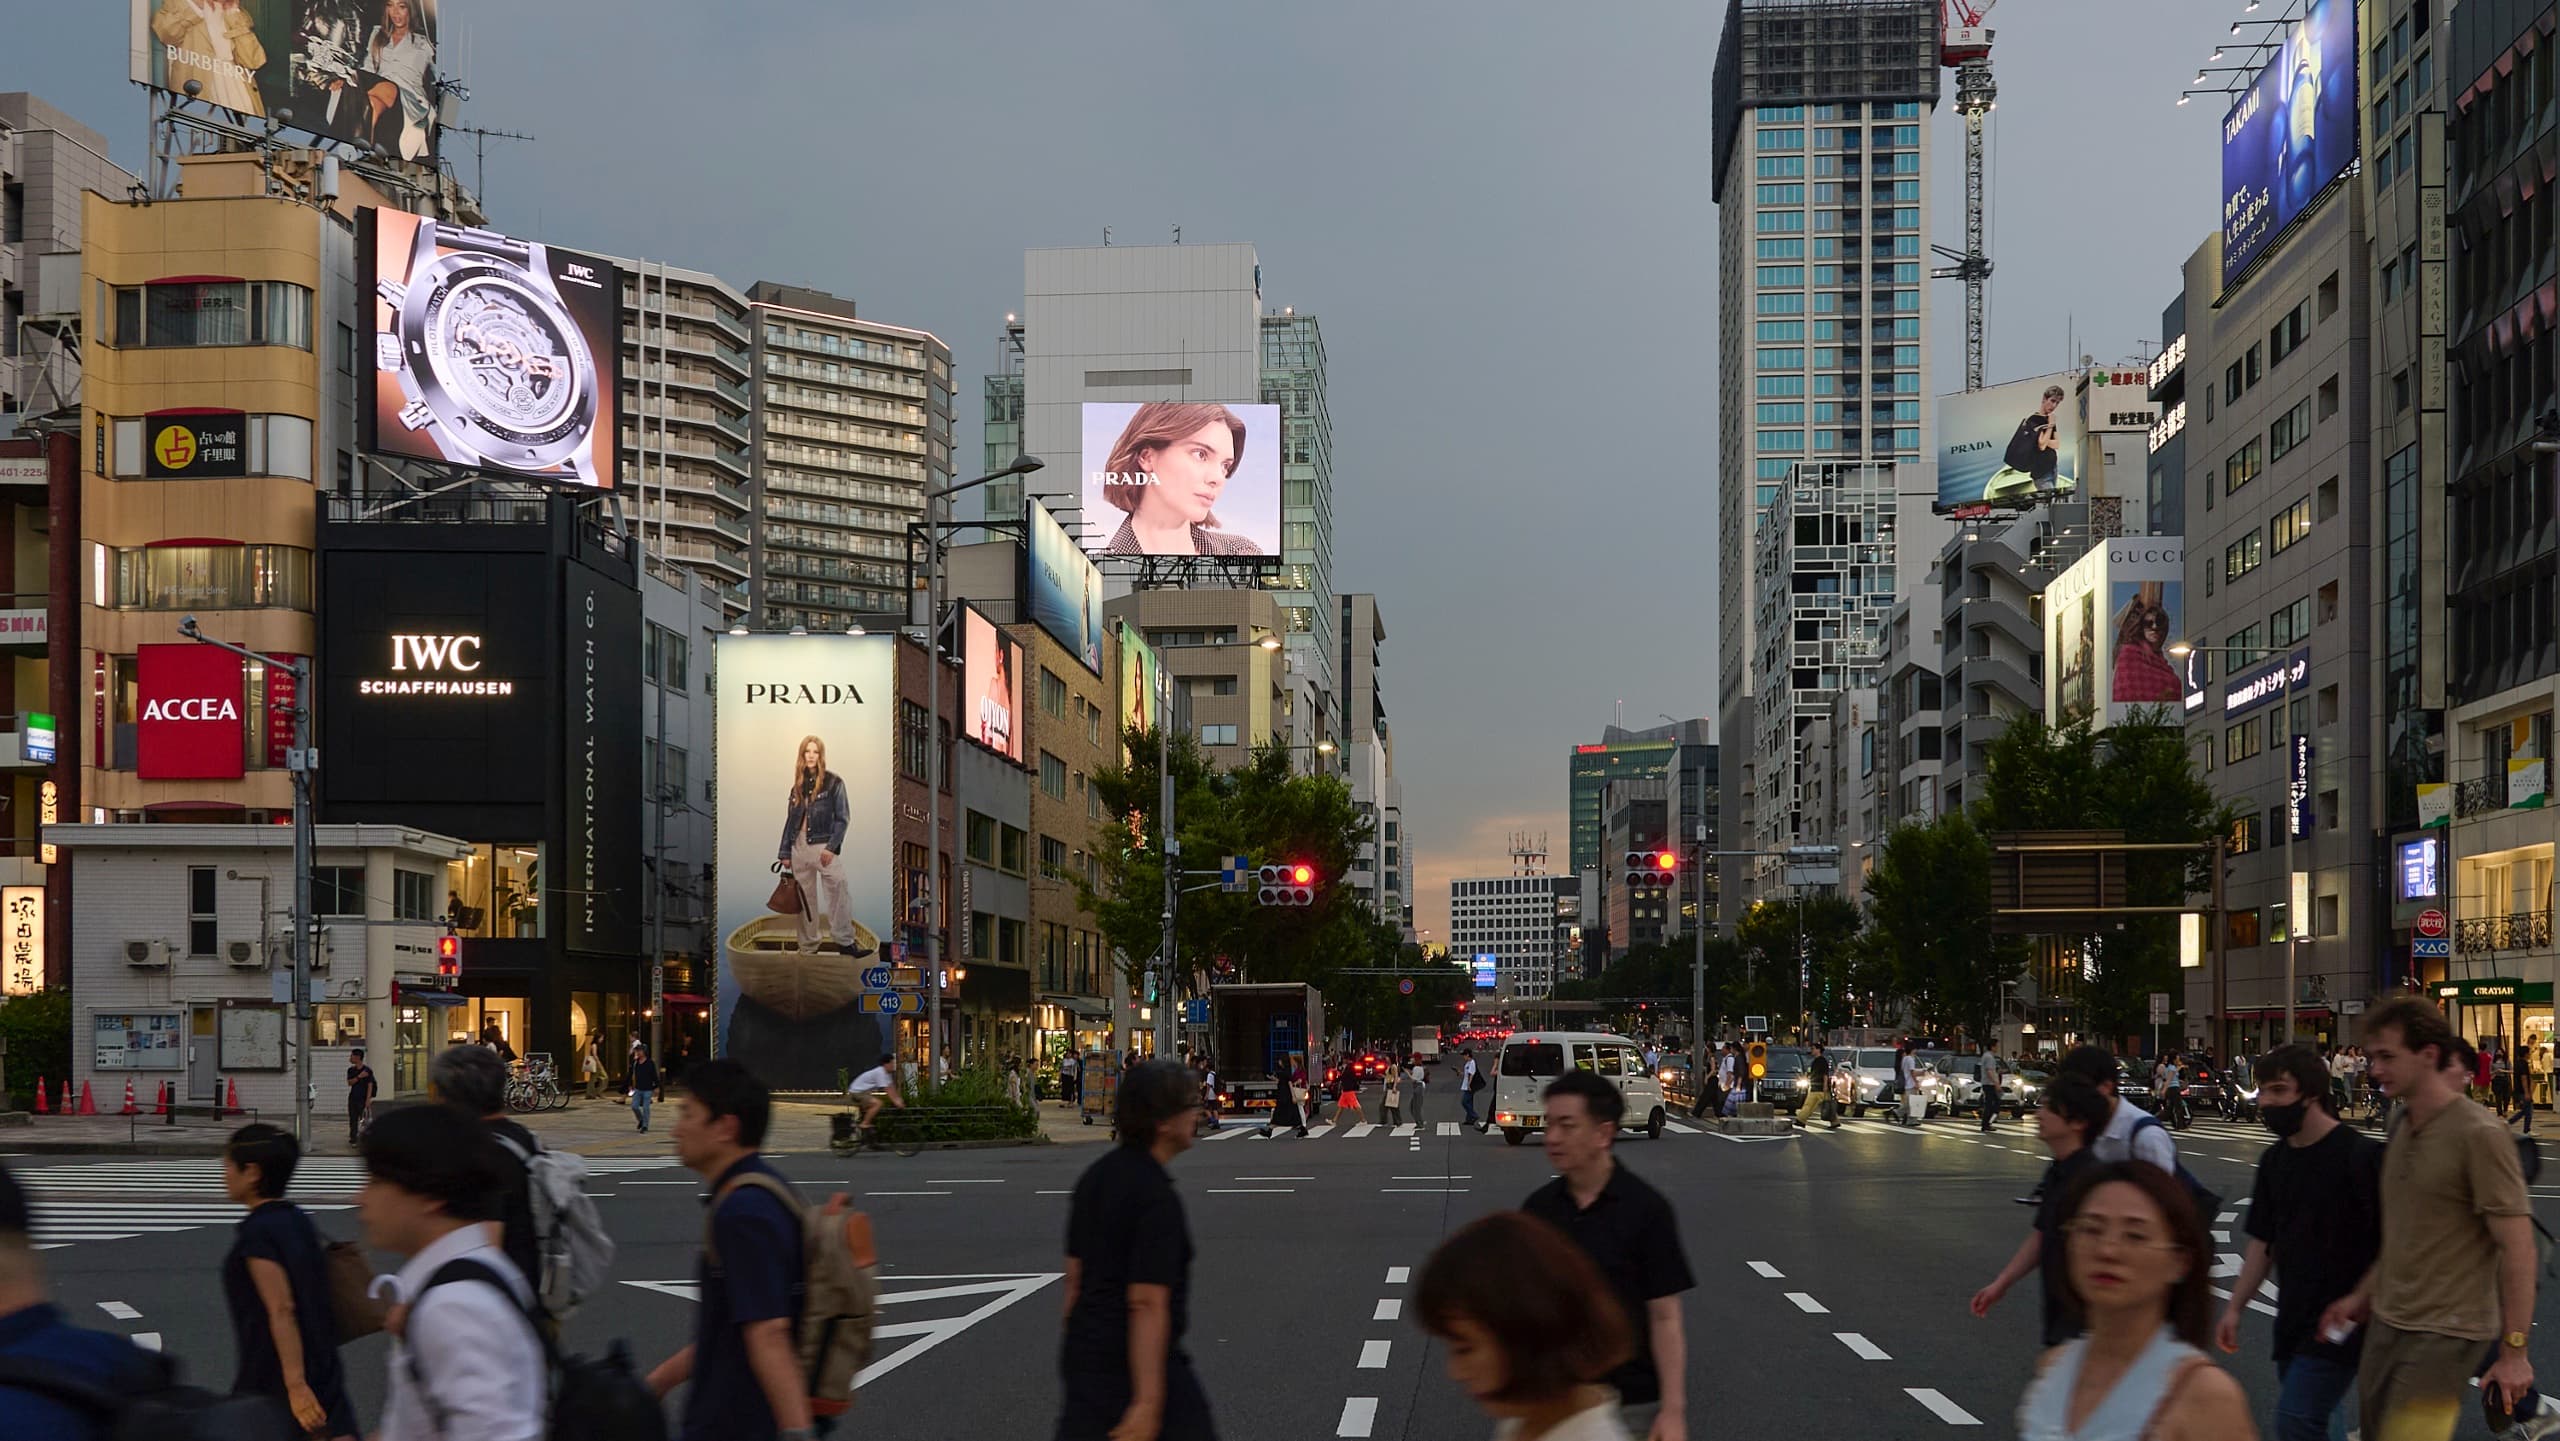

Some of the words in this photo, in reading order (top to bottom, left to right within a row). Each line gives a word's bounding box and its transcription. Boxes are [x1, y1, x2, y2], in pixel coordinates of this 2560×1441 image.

[167, 44, 256, 84] BURBERRY
[2225, 87, 2259, 144] TAKAMI
[568, 263, 594, 279] IWC
[2111, 373, 2148, 385] 健康相
[164, 427, 190, 465] 占
[200, 431, 236, 445] 占いの館
[201, 448, 236, 462] 千里眼
[1951, 441, 1992, 454] PRADA
[1092, 471, 1161, 486] PRADA
[2110, 551, 2183, 563] GUCCI
[2055, 555, 2096, 607] GUCCI
[585, 589, 595, 629] CO.
[391, 635, 481, 671] IWC
[360, 681, 512, 694] SCHAFFHAUSEN
[585, 640, 594, 723] WATCH
[745, 683, 865, 704] PRADA
[143, 699, 238, 720] ACCEA
[585, 735, 594, 933] INTERNATIONAL
[871, 972, 889, 984] 413
[881, 997, 899, 1008] 413
